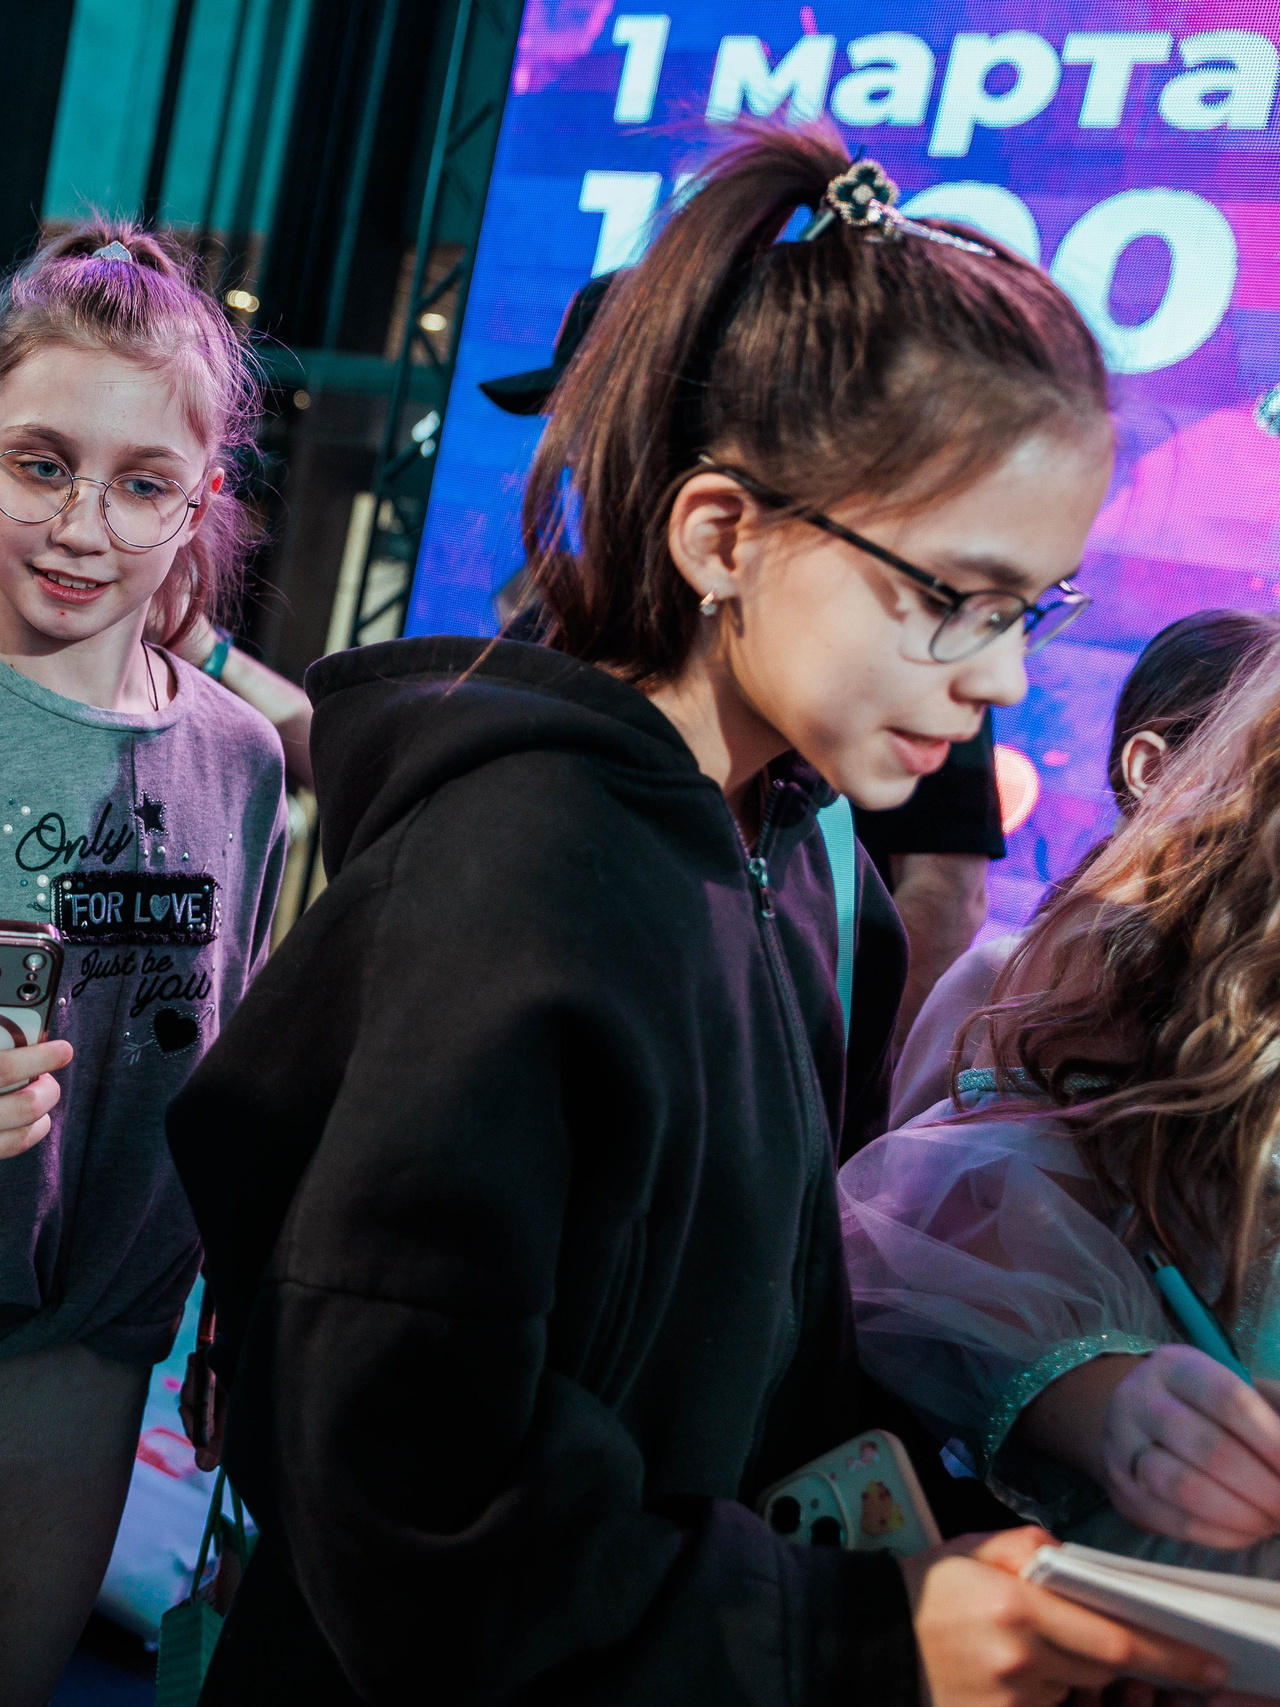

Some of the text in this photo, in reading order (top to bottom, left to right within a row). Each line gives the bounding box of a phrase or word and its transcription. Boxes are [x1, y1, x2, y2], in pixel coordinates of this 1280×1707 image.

[612, 13, 1280, 158] 1 марта
[15, 802, 134, 872] Only
[72, 891, 124, 926] FOR
[141, 947, 174, 975] be
[129, 972, 211, 1018] you
